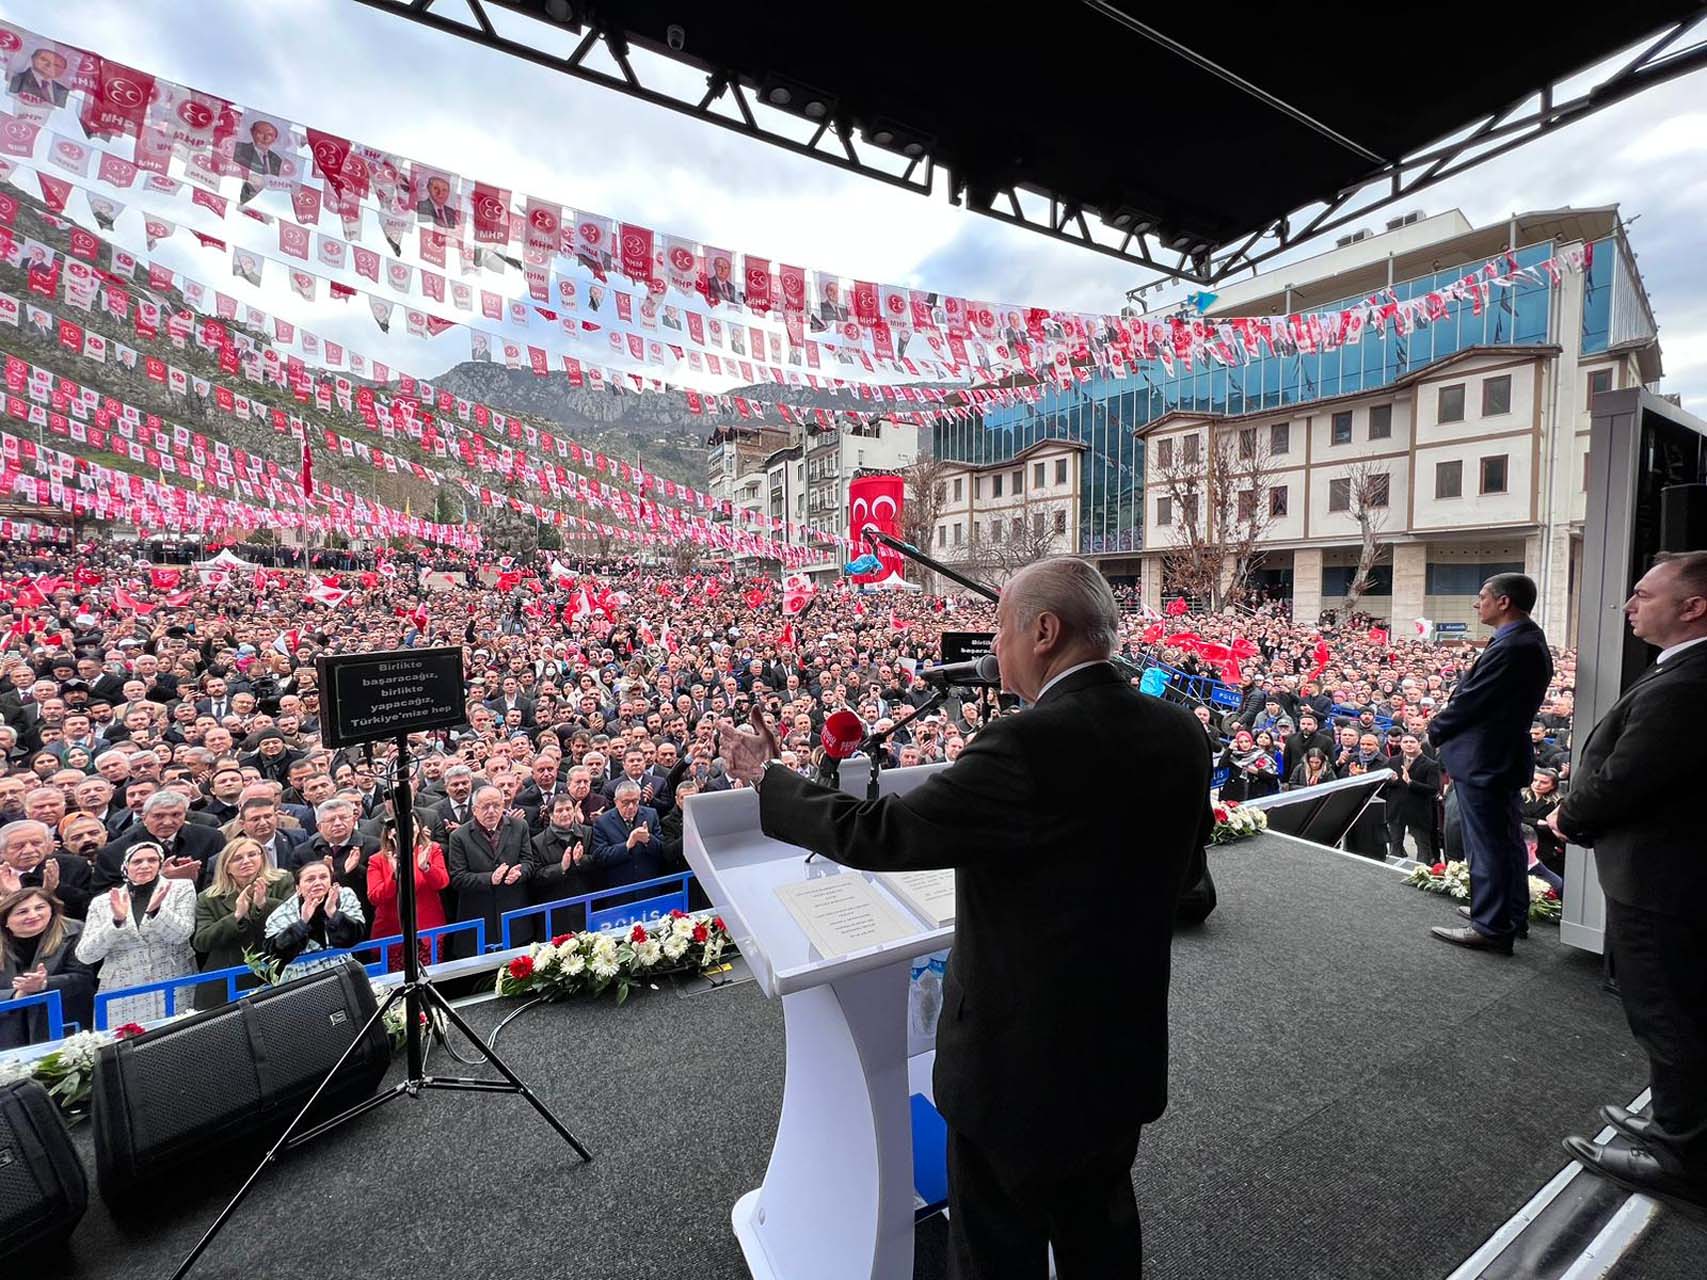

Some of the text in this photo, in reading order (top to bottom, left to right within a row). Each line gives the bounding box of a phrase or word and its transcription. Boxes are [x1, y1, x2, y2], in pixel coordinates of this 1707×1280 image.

[479, 230, 504, 240] MHP
[529, 239, 554, 250] MHP
[860, 316, 878, 325] MHP
[379, 661, 423, 672] Birlikte
[381, 685, 424, 697] birlikte
[370, 697, 435, 713] yapacağız,
[350, 705, 452, 727] Türkiye'mize hep
